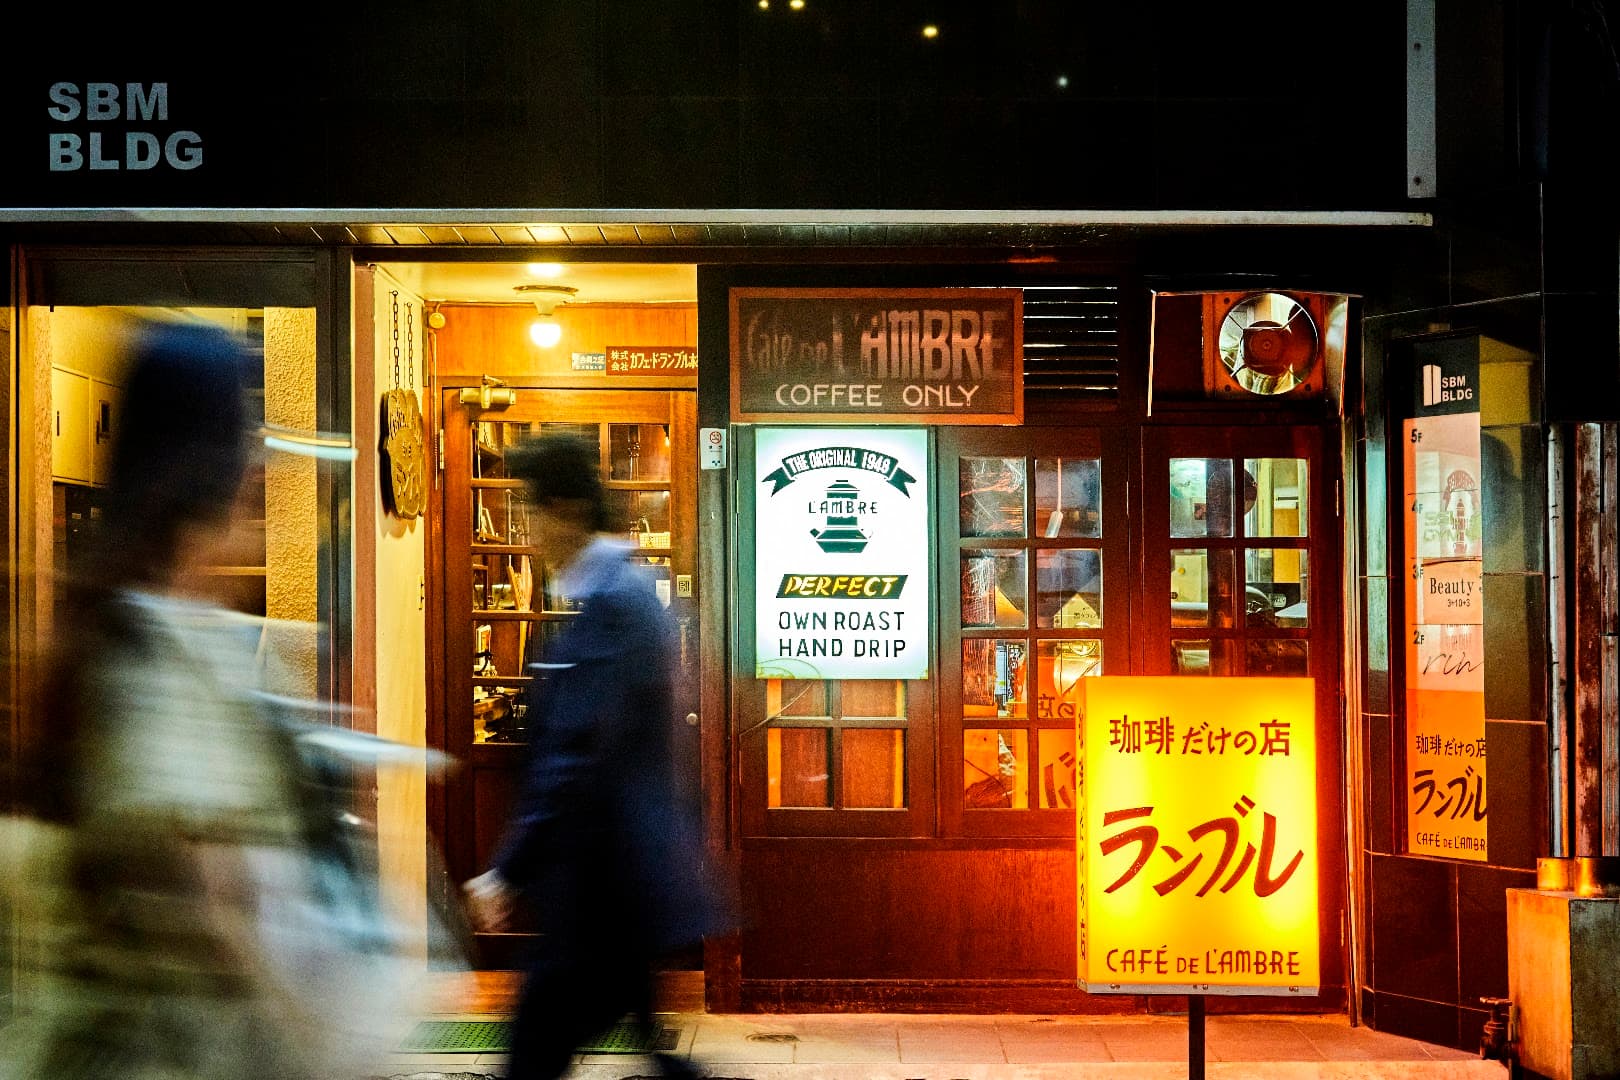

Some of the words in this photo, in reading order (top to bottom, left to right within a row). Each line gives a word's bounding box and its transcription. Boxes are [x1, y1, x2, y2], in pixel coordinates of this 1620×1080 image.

[48, 82, 168, 121] SBM
[49, 130, 203, 171] BLDG
[1442, 376, 1466, 388] SBM
[775, 384, 883, 406] COFFEE
[902, 384, 979, 407] ONLY
[1442, 388, 1473, 402] BLDG
[1411, 428, 1422, 443] 5F
[785, 454, 809, 474] THE
[809, 448, 857, 468] ORIGINAL
[861, 451, 891, 474] 1948
[808, 501, 878, 514] L'AMBRE
[784, 576, 899, 597] PERFECT
[1430, 577, 1474, 596] Beauty
[779, 611, 827, 630] OWN
[834, 611, 905, 631] ROAST
[1413, 630, 1424, 645] 2F
[779, 638, 843, 657] HAND
[854, 639, 906, 658] DRIP
[1110, 715, 1291, 756] 珈琲だけの店
[1413, 765, 1487, 822] ランブル
[1100, 794, 1304, 898] ランブル
[1454, 836, 1485, 851] L'AMBR
[1106, 945, 1169, 975] CAFÉ
[1176, 957, 1199, 974] DE
[1205, 948, 1300, 976] L'AMBRE
